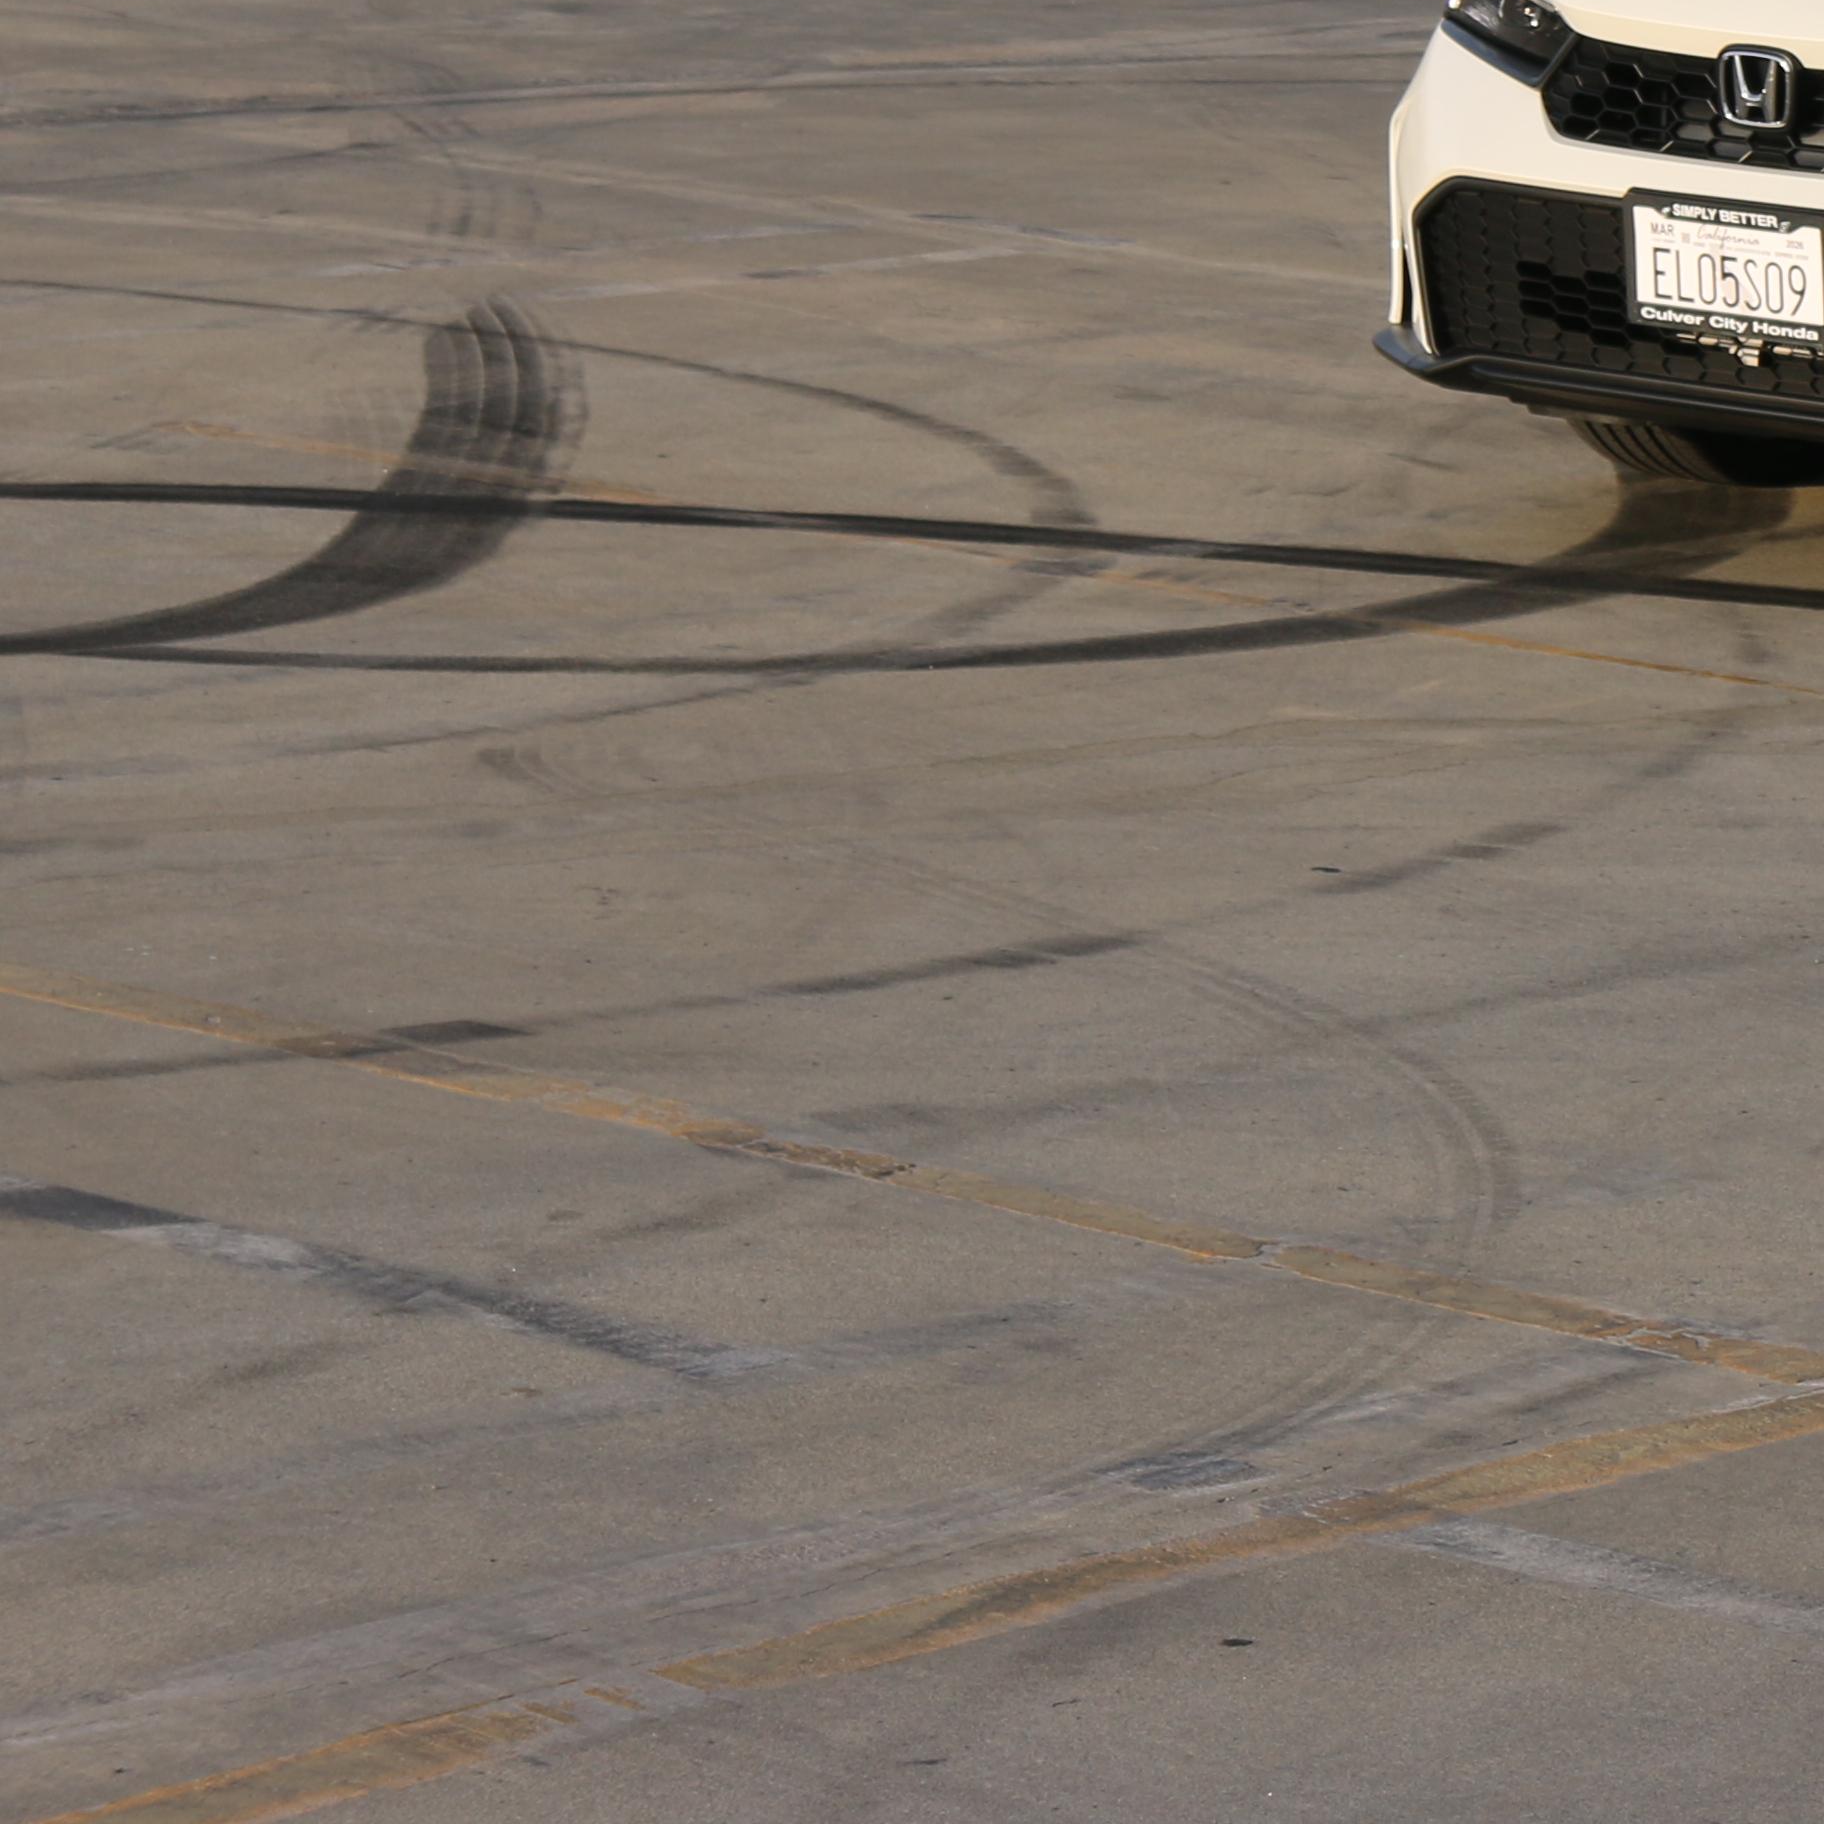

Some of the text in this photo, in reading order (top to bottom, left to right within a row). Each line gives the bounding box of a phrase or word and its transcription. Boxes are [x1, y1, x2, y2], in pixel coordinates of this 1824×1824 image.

[1672, 204, 1778, 228] SIMPLY BETTER
[1650, 222, 1675, 236] MAR
[1697, 223, 1760, 249] California
[1653, 247, 1807, 317] EL05S09
[1640, 306, 1819, 341] Culver City Honda
